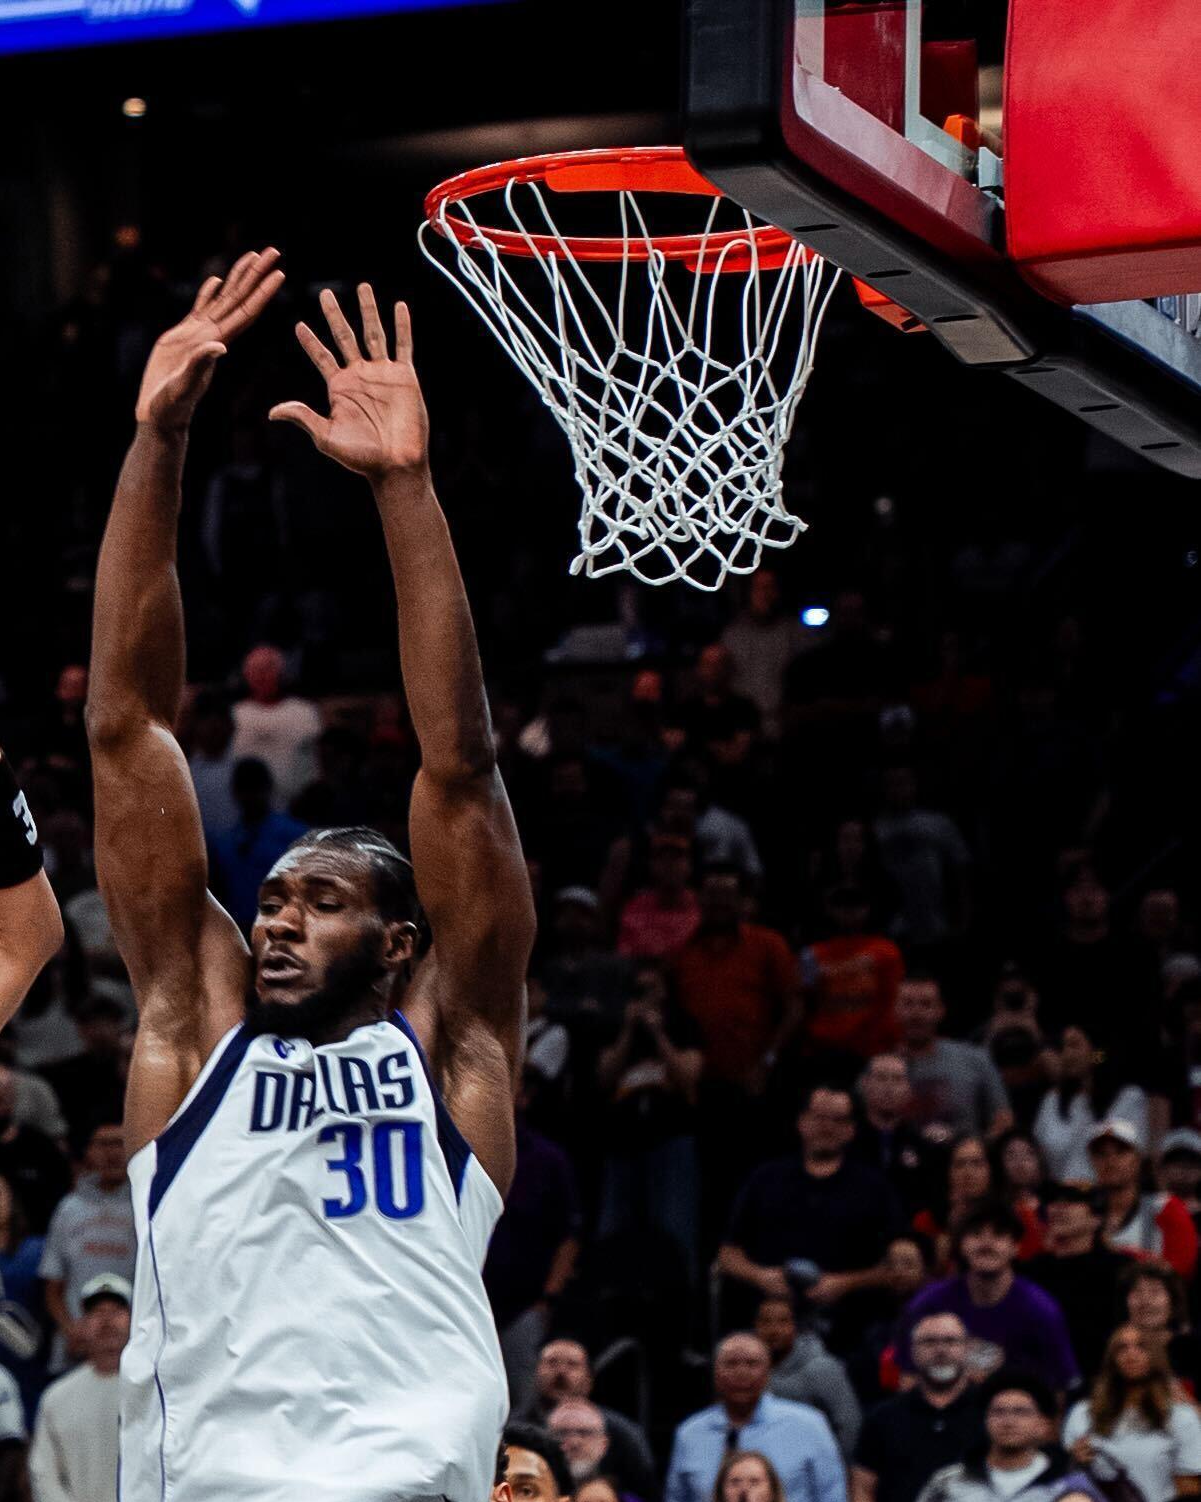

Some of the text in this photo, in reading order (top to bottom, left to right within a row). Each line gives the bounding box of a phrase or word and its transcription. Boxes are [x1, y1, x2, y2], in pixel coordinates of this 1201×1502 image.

[12, 789, 38, 846] 3
[250, 1051, 416, 1132] DALAS
[318, 1120, 425, 1220] 30
